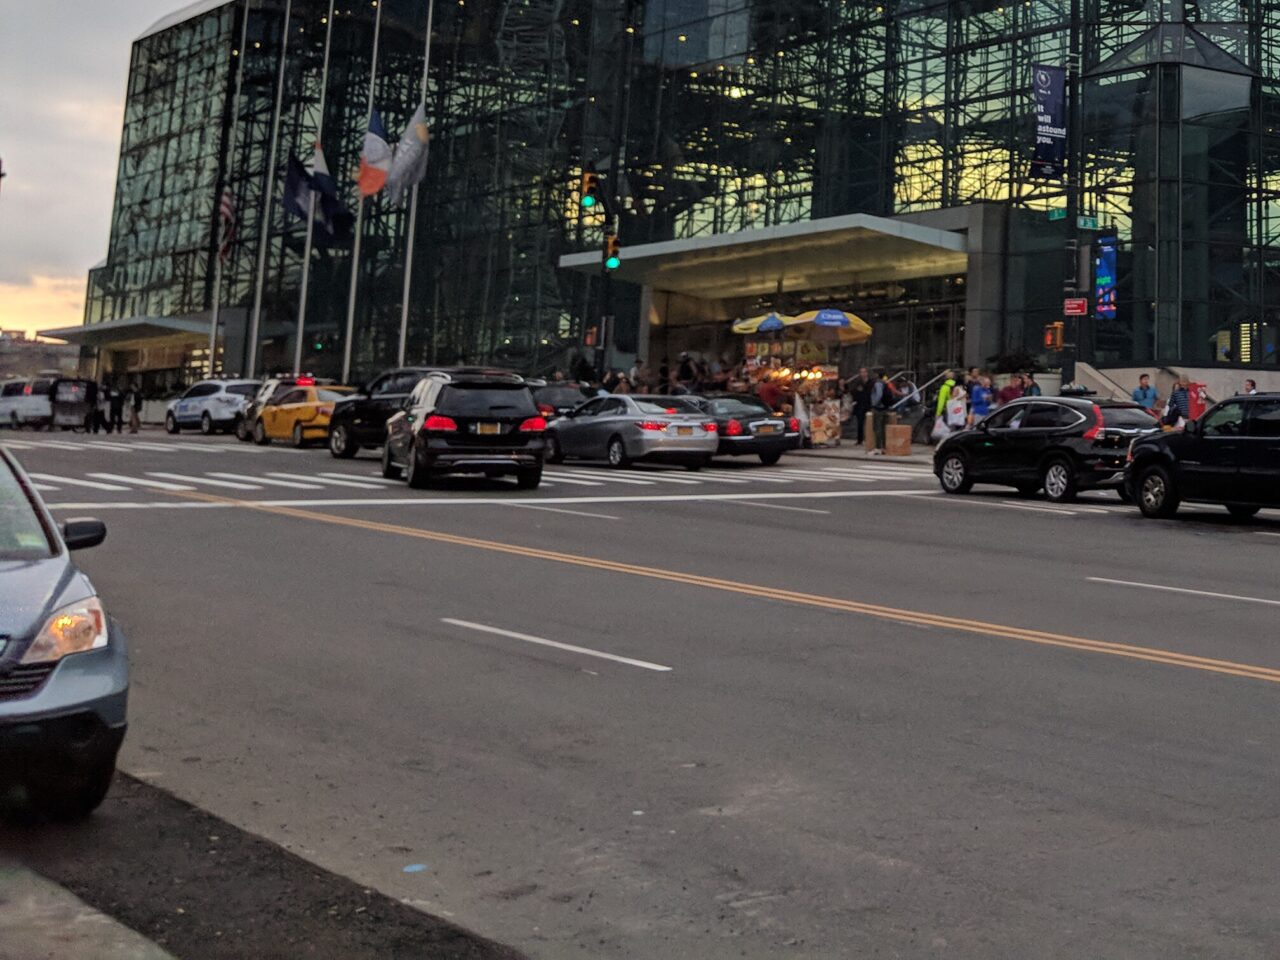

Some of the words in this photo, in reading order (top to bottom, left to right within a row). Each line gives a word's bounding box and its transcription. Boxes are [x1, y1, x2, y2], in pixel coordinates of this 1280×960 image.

[1037, 114, 1052, 124] will
[1037, 124, 1067, 136] astound
[1036, 135, 1054, 145] you.
